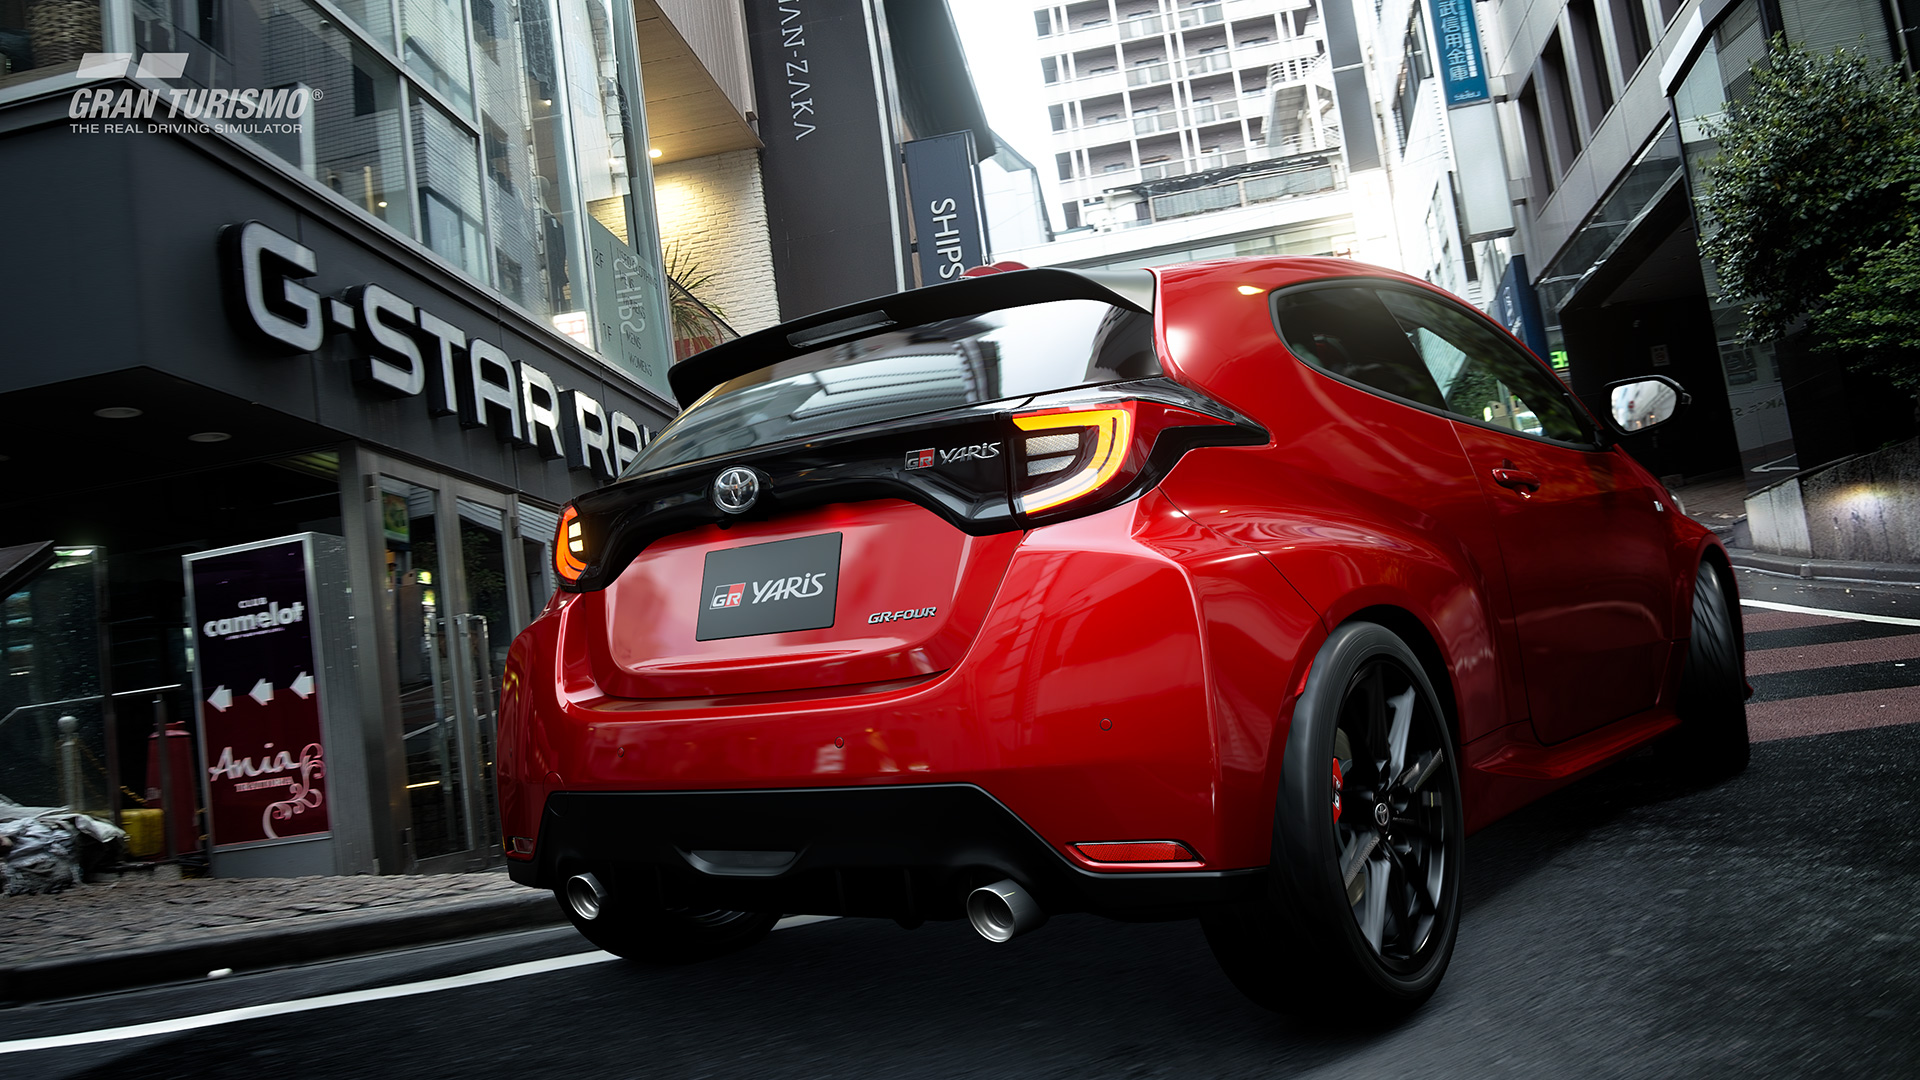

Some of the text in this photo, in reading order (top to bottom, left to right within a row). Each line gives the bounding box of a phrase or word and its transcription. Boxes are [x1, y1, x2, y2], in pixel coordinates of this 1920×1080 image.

[778, 0, 816, 141] AN-ZAKA
[931, 198, 965, 279] SHIPS
[240, 219, 663, 479] G-STAR RA
[628, 351, 653, 377] WOMENS
[907, 454, 933, 469] GR
[712, 590, 742, 607] GR
[867, 606, 937, 624] GR-FOUR
[203, 601, 305, 637] camelot
[208, 743, 300, 781] Ania
